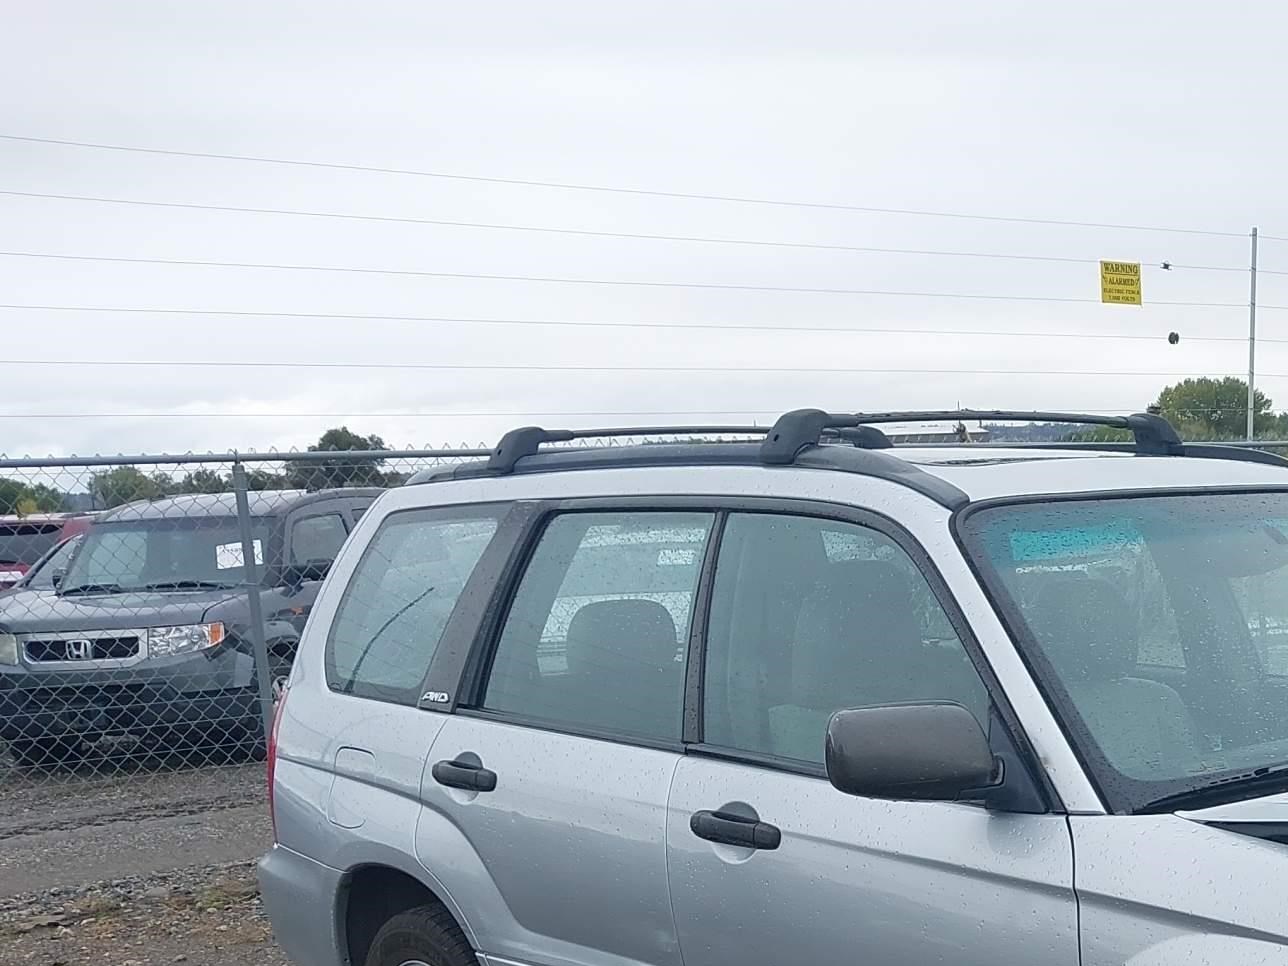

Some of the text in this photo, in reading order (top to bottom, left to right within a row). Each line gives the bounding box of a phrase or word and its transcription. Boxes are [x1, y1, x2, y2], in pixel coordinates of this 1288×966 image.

[1103, 262, 1138, 274] WARNING
[1108, 276, 1135, 286] ALARMED
[421, 691, 449, 703] AWD
